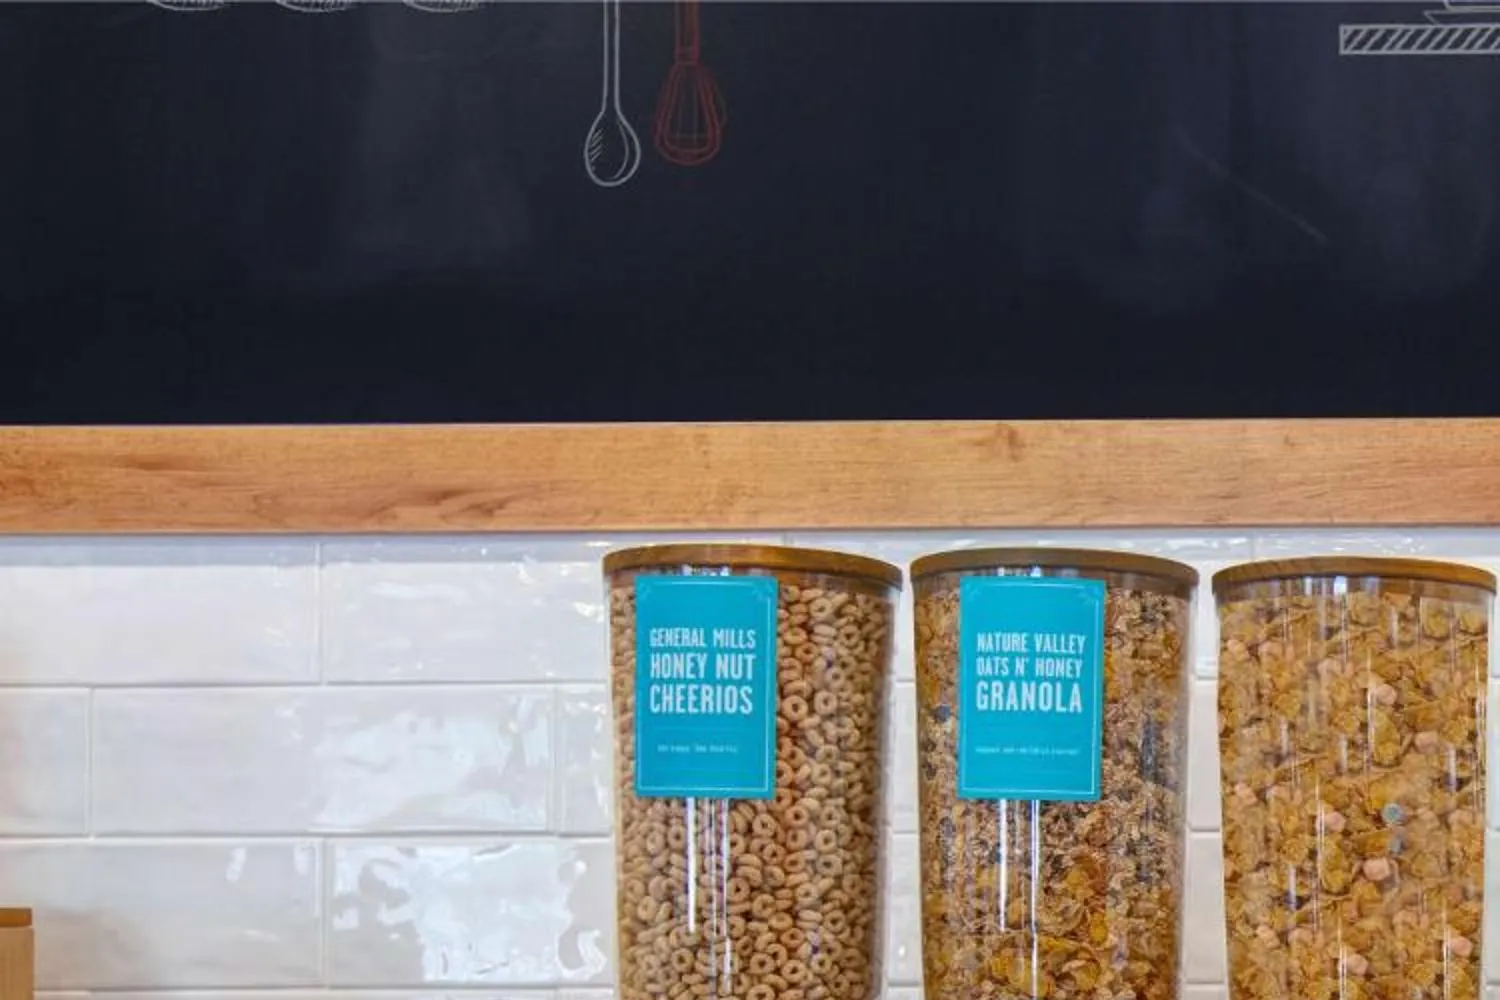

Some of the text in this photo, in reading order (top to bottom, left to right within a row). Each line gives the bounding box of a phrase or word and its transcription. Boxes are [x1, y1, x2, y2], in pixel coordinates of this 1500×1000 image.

[650, 627, 756, 649] GENERAL MILLS
[977, 632, 1086, 655] NATURE VALLEY
[650, 654, 754, 680] HONEY NUT
[976, 657, 1009, 677] OATS
[1035, 659, 1083, 679] HONEY
[650, 685, 753, 715] CHEERIOS
[976, 681, 1083, 713] GRANOLA
